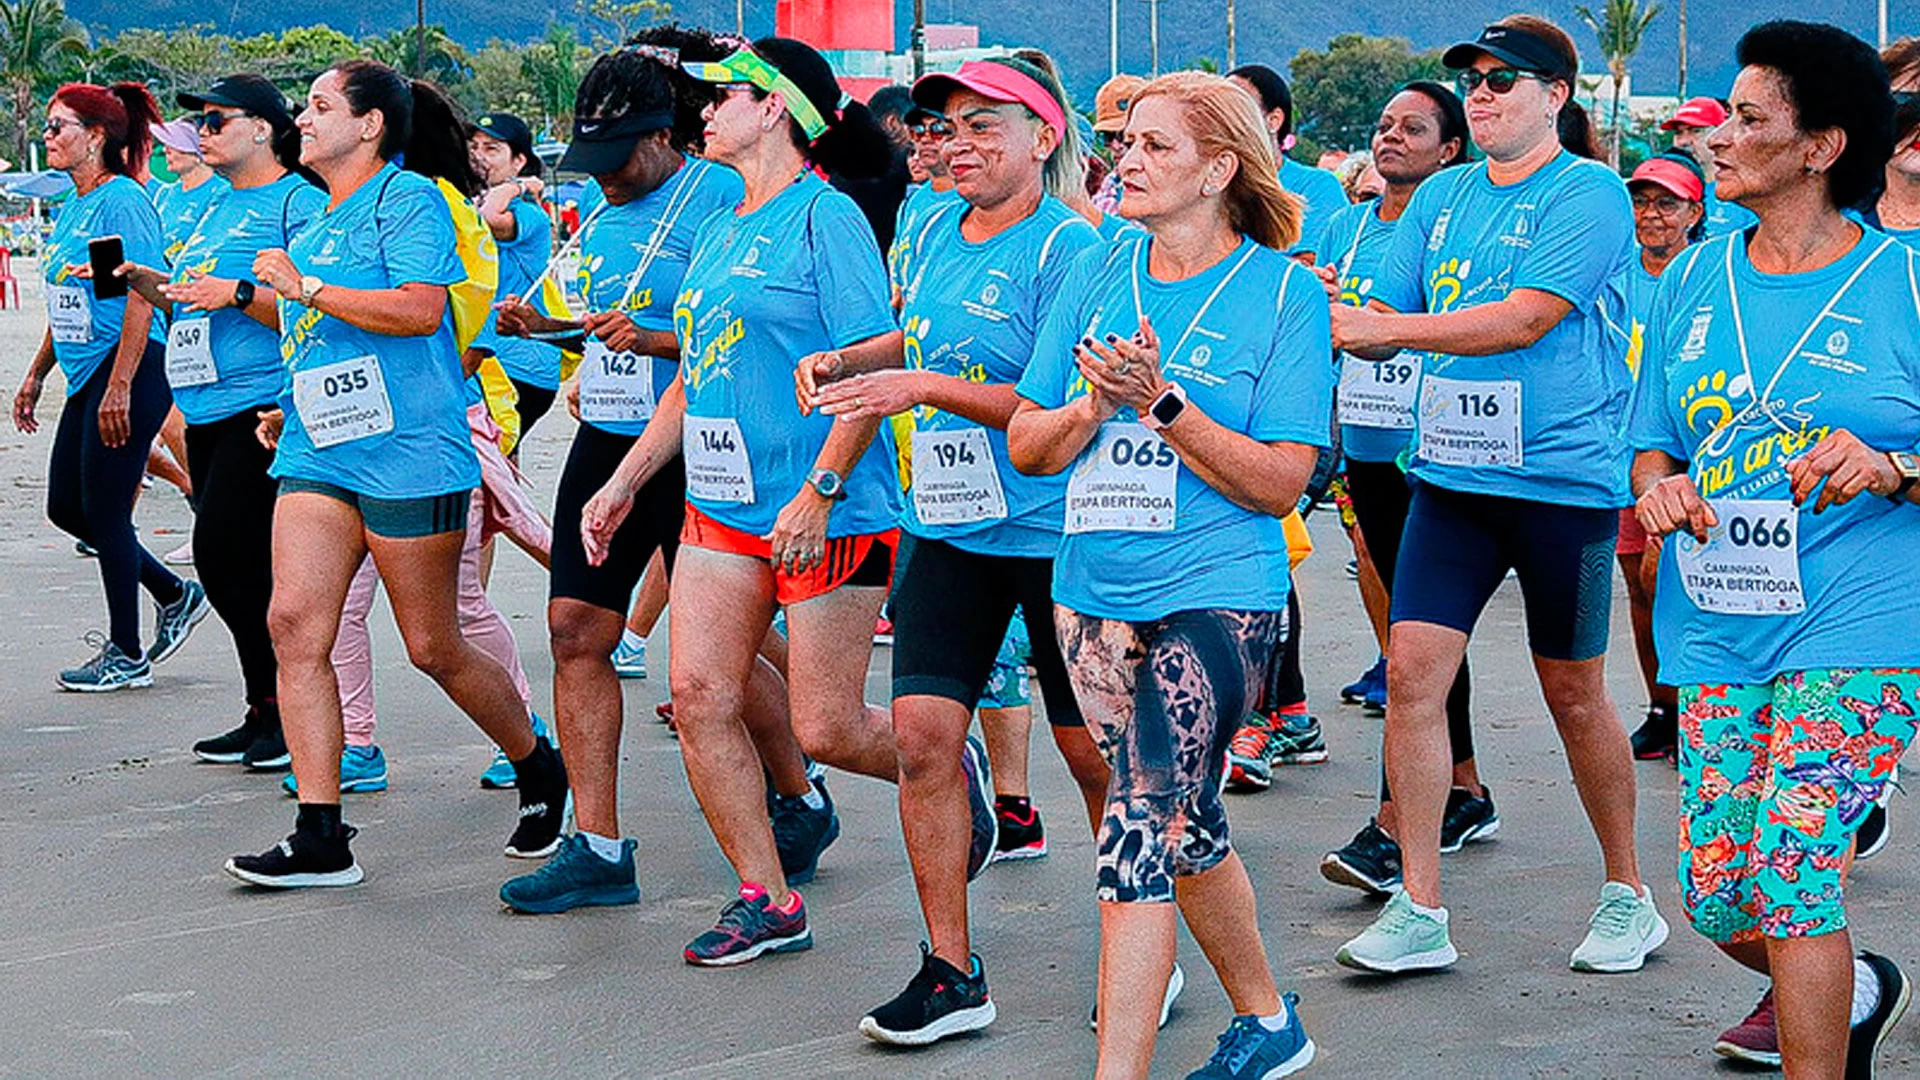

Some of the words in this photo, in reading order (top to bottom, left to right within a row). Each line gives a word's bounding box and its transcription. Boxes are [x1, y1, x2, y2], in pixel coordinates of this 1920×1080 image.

[601, 354, 637, 376] 142
[1372, 362, 1413, 384] 139
[324, 368, 369, 397] 035
[599, 396, 645, 406] BERTIOGA
[1361, 402, 1412, 415] BERTIOGA
[1458, 394, 1499, 417] 116
[329, 408, 381, 429] BERTIOGA
[701, 430, 736, 453] 144
[1448, 438, 1509, 451] BERTIOGA
[933, 442, 975, 467] 194
[1111, 438, 1175, 467] 065
[1701, 455, 1735, 498] na
[939, 489, 991, 504] BERTIOGA
[1086, 482, 1148, 494] CAMINHADA
[1100, 495, 1174, 509] BERTIOGA
[1729, 516, 1792, 548] 066
[1703, 562, 1771, 577] CAMINHADA
[1686, 574, 1725, 590] ETAPA
[1726, 577, 1800, 593] BERTIOGA
